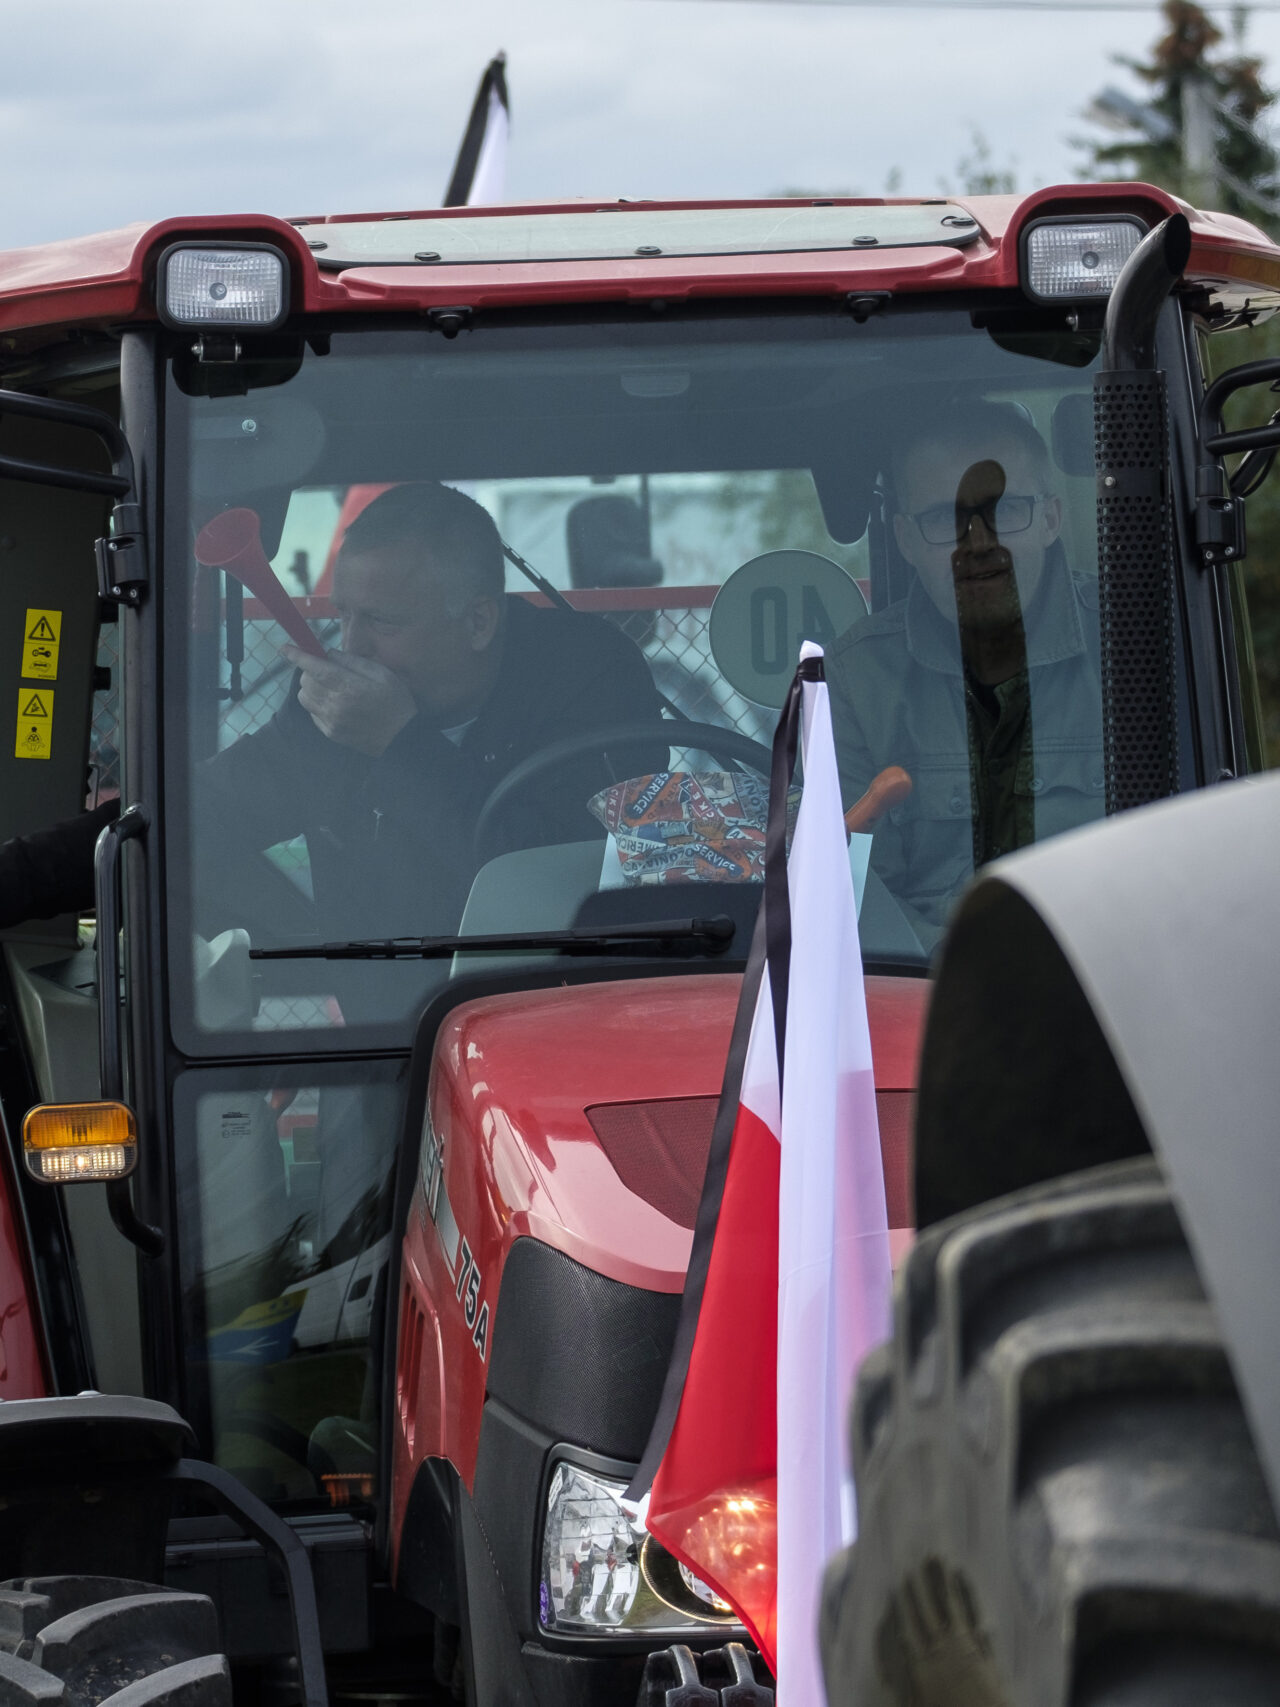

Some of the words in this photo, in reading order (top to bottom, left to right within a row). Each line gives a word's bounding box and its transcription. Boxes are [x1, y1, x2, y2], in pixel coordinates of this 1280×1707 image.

[632, 772, 669, 814] SERVICE
[694, 843, 736, 871] SERVICE
[455, 1234, 490, 1364] 75A
